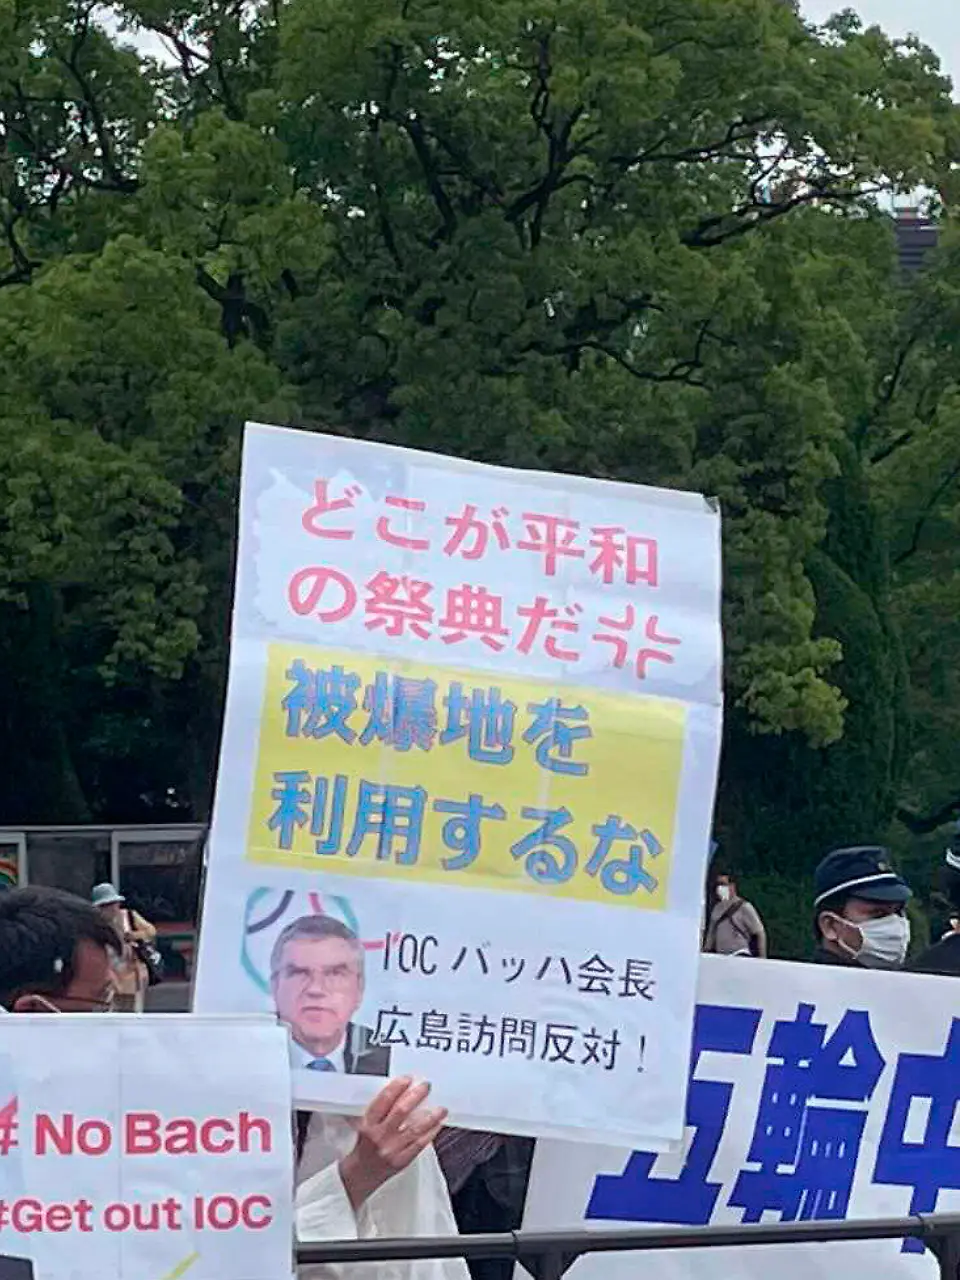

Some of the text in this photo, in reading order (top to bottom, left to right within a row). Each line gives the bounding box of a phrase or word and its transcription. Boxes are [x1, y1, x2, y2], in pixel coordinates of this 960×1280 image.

[302, 478, 658, 587] どこが平和
[287, 566, 583, 662] の祭典だ
[281, 658, 593, 776] 被爆地を
[267, 770, 665, 896] 利用するな
[383, 931, 657, 1001] IOC バッハ会長
[371, 1005, 647, 1073] 広島訪問反対！
[35, 1113, 112, 1156] No
[125, 1111, 272, 1155] Bach
[104, 1197, 182, 1231] out
[194, 1195, 273, 1230] IOC
